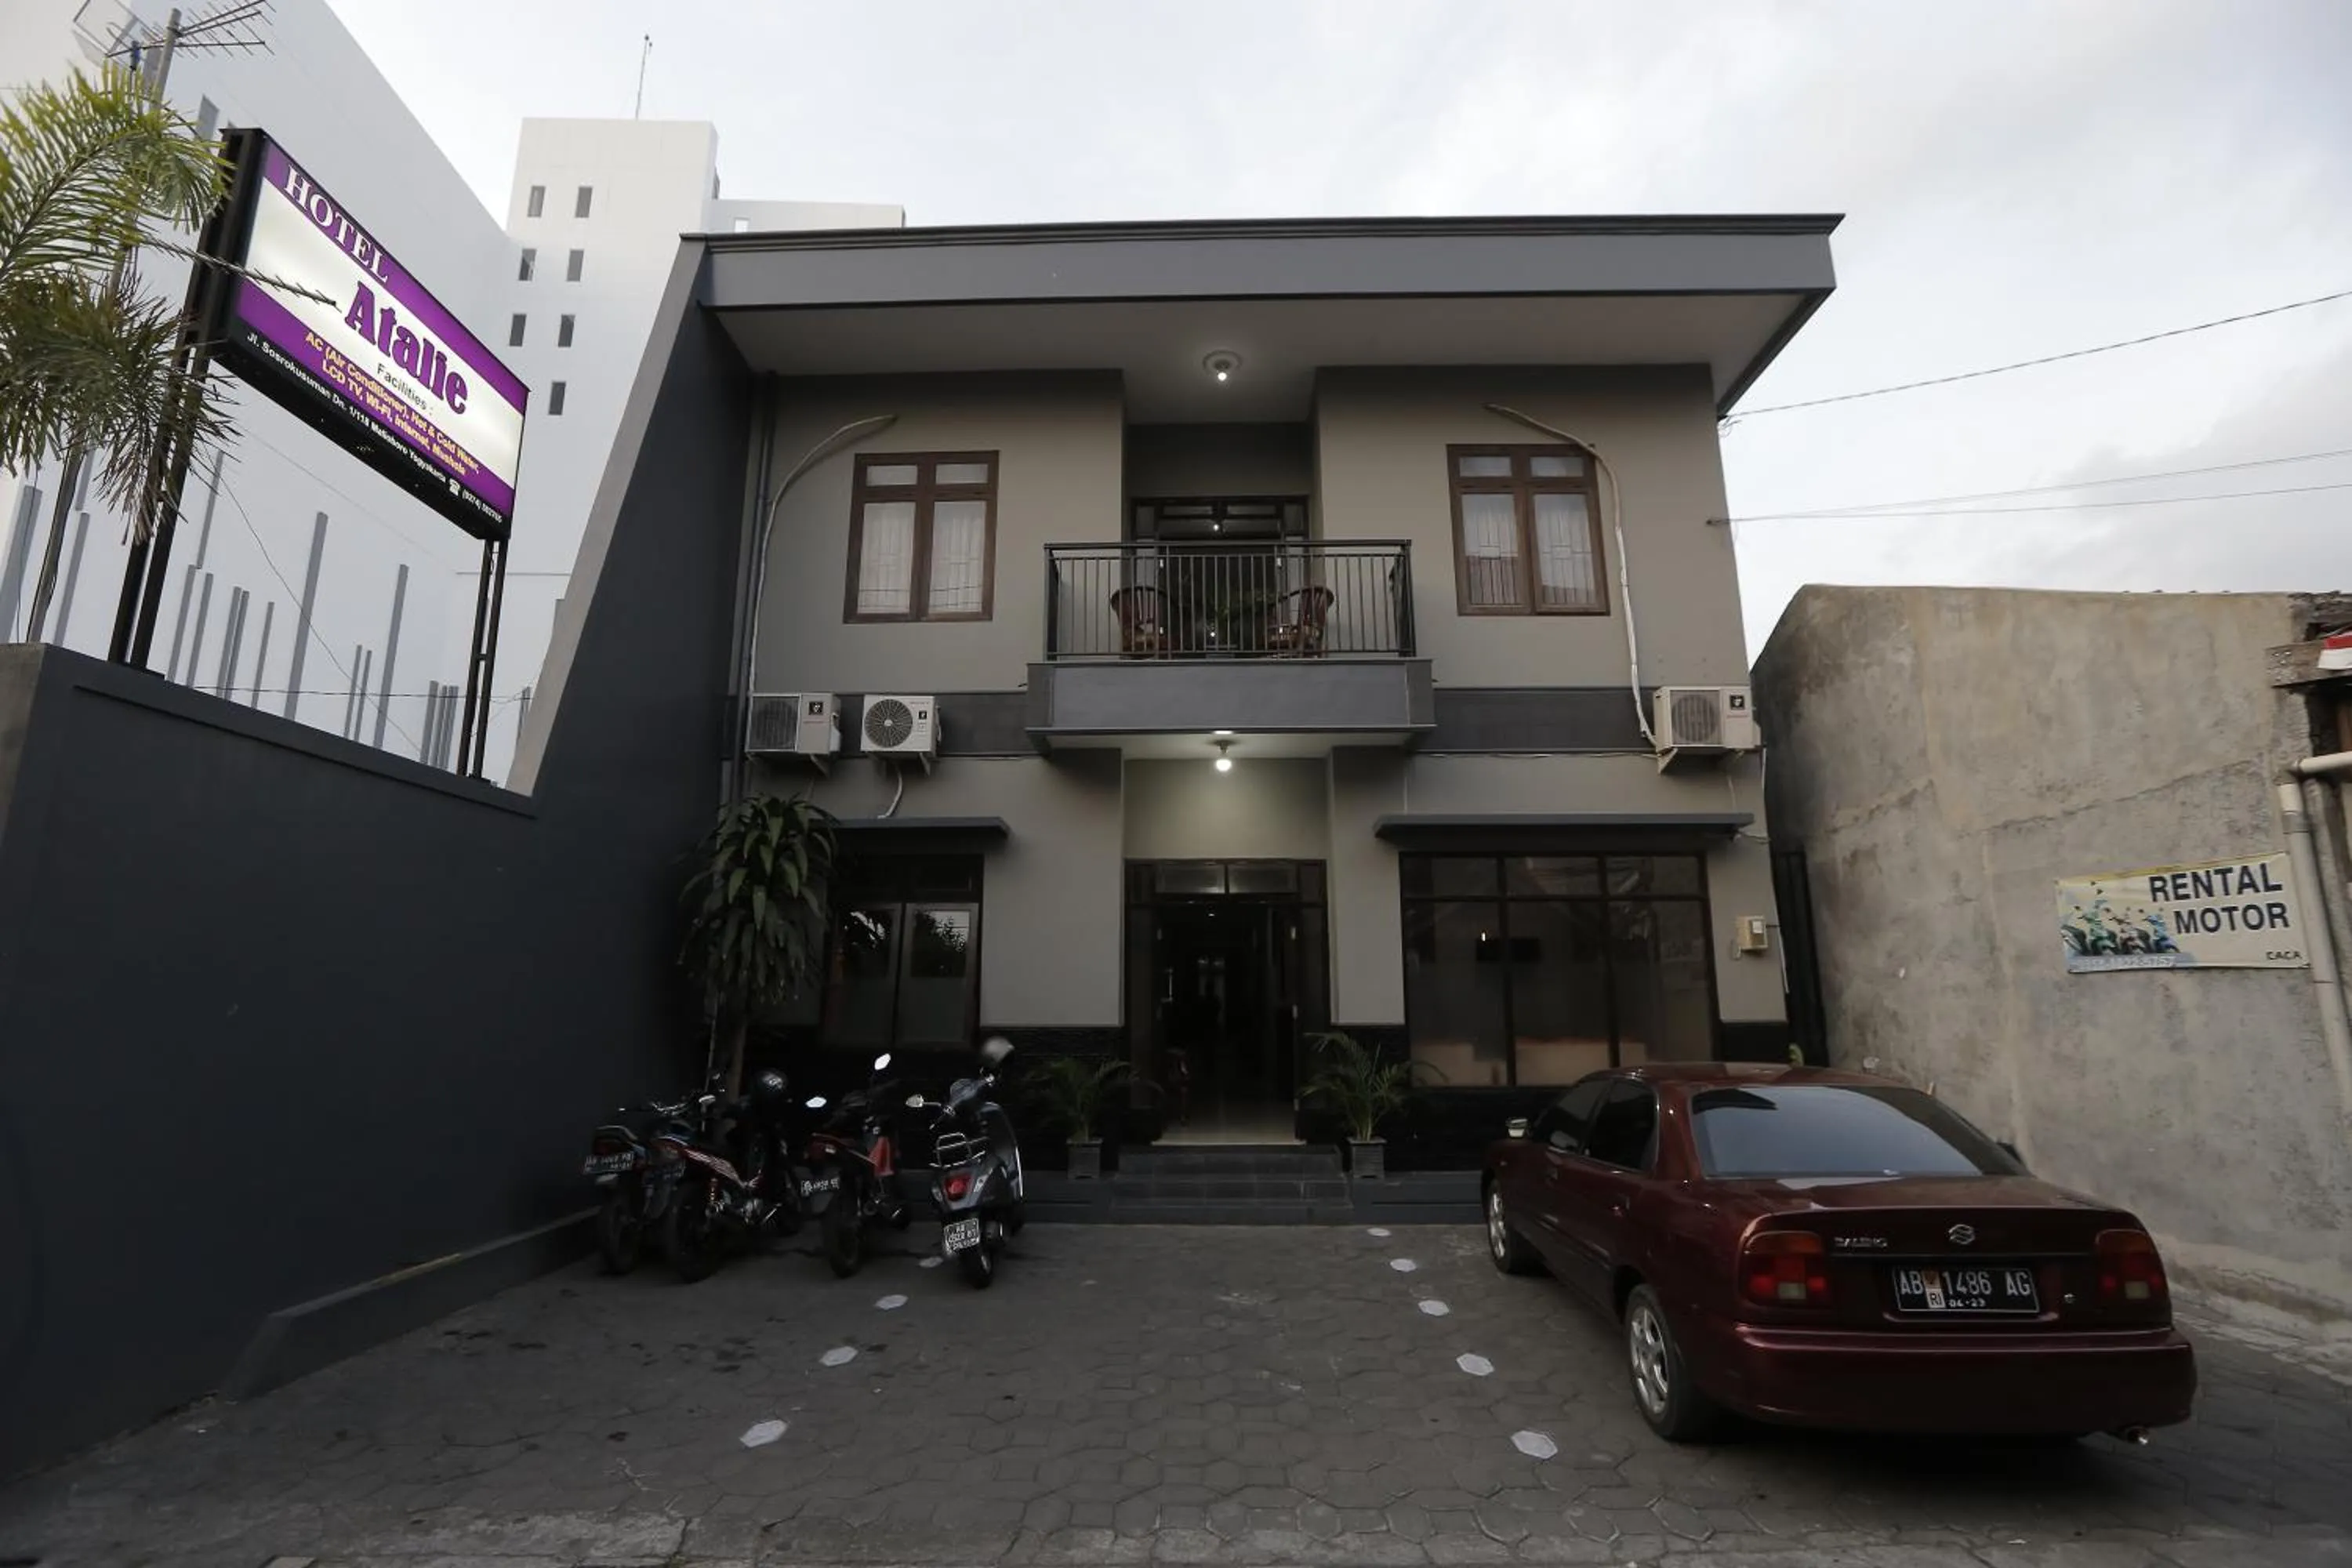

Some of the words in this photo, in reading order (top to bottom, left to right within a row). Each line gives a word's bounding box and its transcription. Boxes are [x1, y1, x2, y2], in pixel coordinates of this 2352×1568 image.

[284, 163, 389, 283] HOTEL
[305, 332, 324, 352] AC
[344, 280, 468, 415] Atalie
[322, 359, 346, 385] LCD
[376, 362, 427, 411] Facilities
[2148, 862, 2283, 903] RENTAL
[2174, 902, 2290, 935] MOTOR
[1899, 1269, 1924, 1296] AB
[2005, 1271, 2032, 1297] AG
